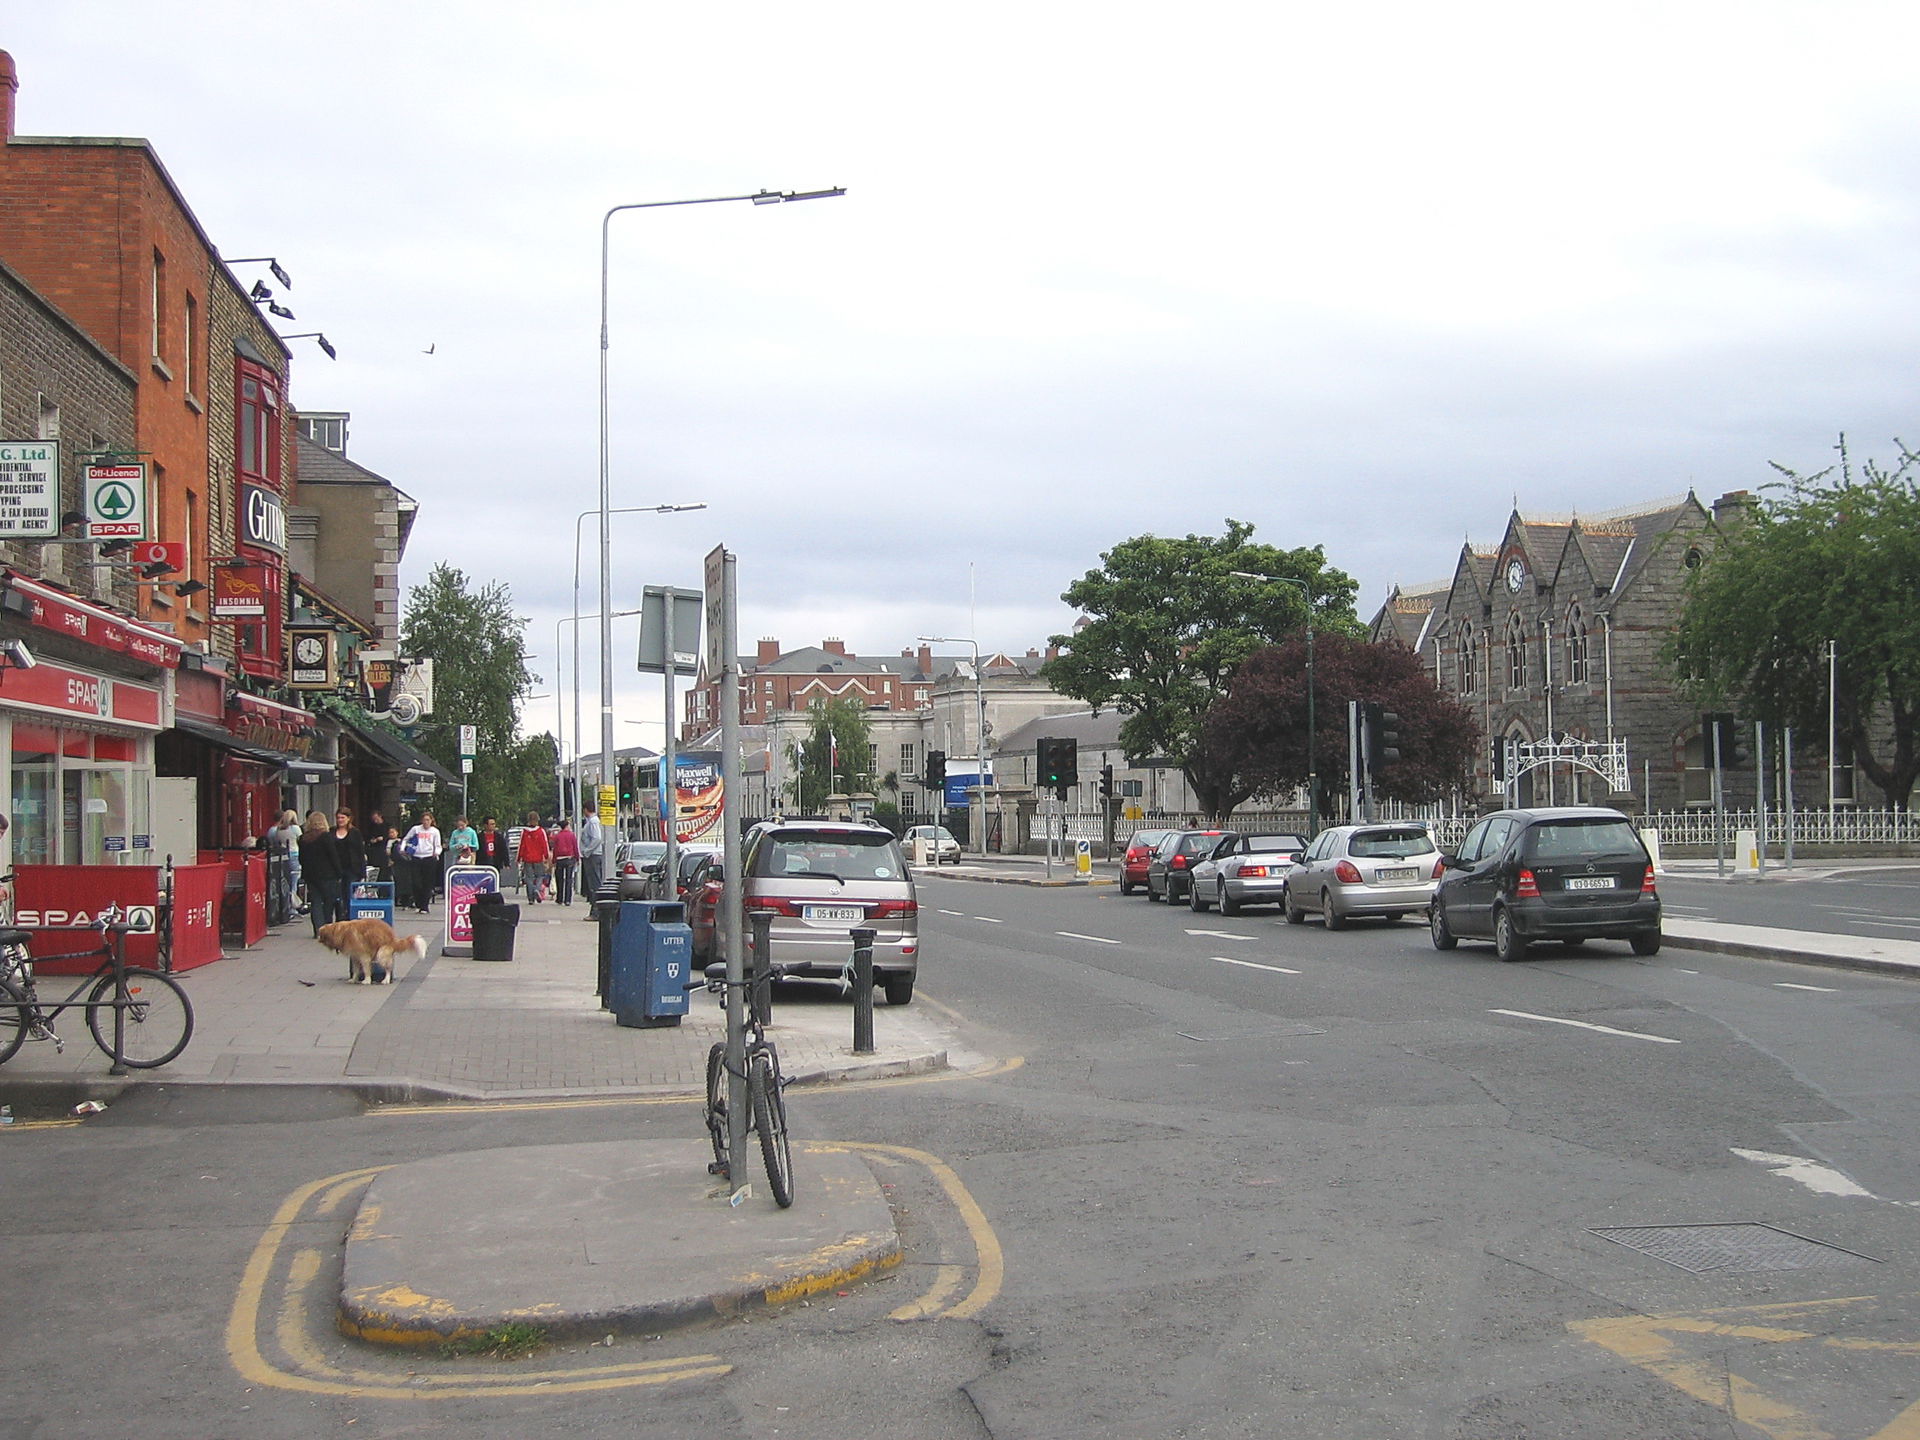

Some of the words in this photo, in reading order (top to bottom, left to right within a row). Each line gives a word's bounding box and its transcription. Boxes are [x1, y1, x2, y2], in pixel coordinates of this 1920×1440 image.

[21, 448, 51, 460] Ltd.
[19, 473, 47, 482] SERVICE
[90, 469, 139, 478] Off-Licence
[0, 485, 44, 494] PROCESSING
[9, 508, 20, 517] FAX
[23, 508, 49, 517] BUREAU
[22, 520, 48, 529] AGENCY
[92, 525, 139, 534] SPAR
[219, 597, 260, 605] INSOMNIA
[68, 678, 98, 709] SPAR
[676, 766, 712, 779] Maxwell
[681, 777, 710, 787] House
[663, 936, 685, 945] LITTER
